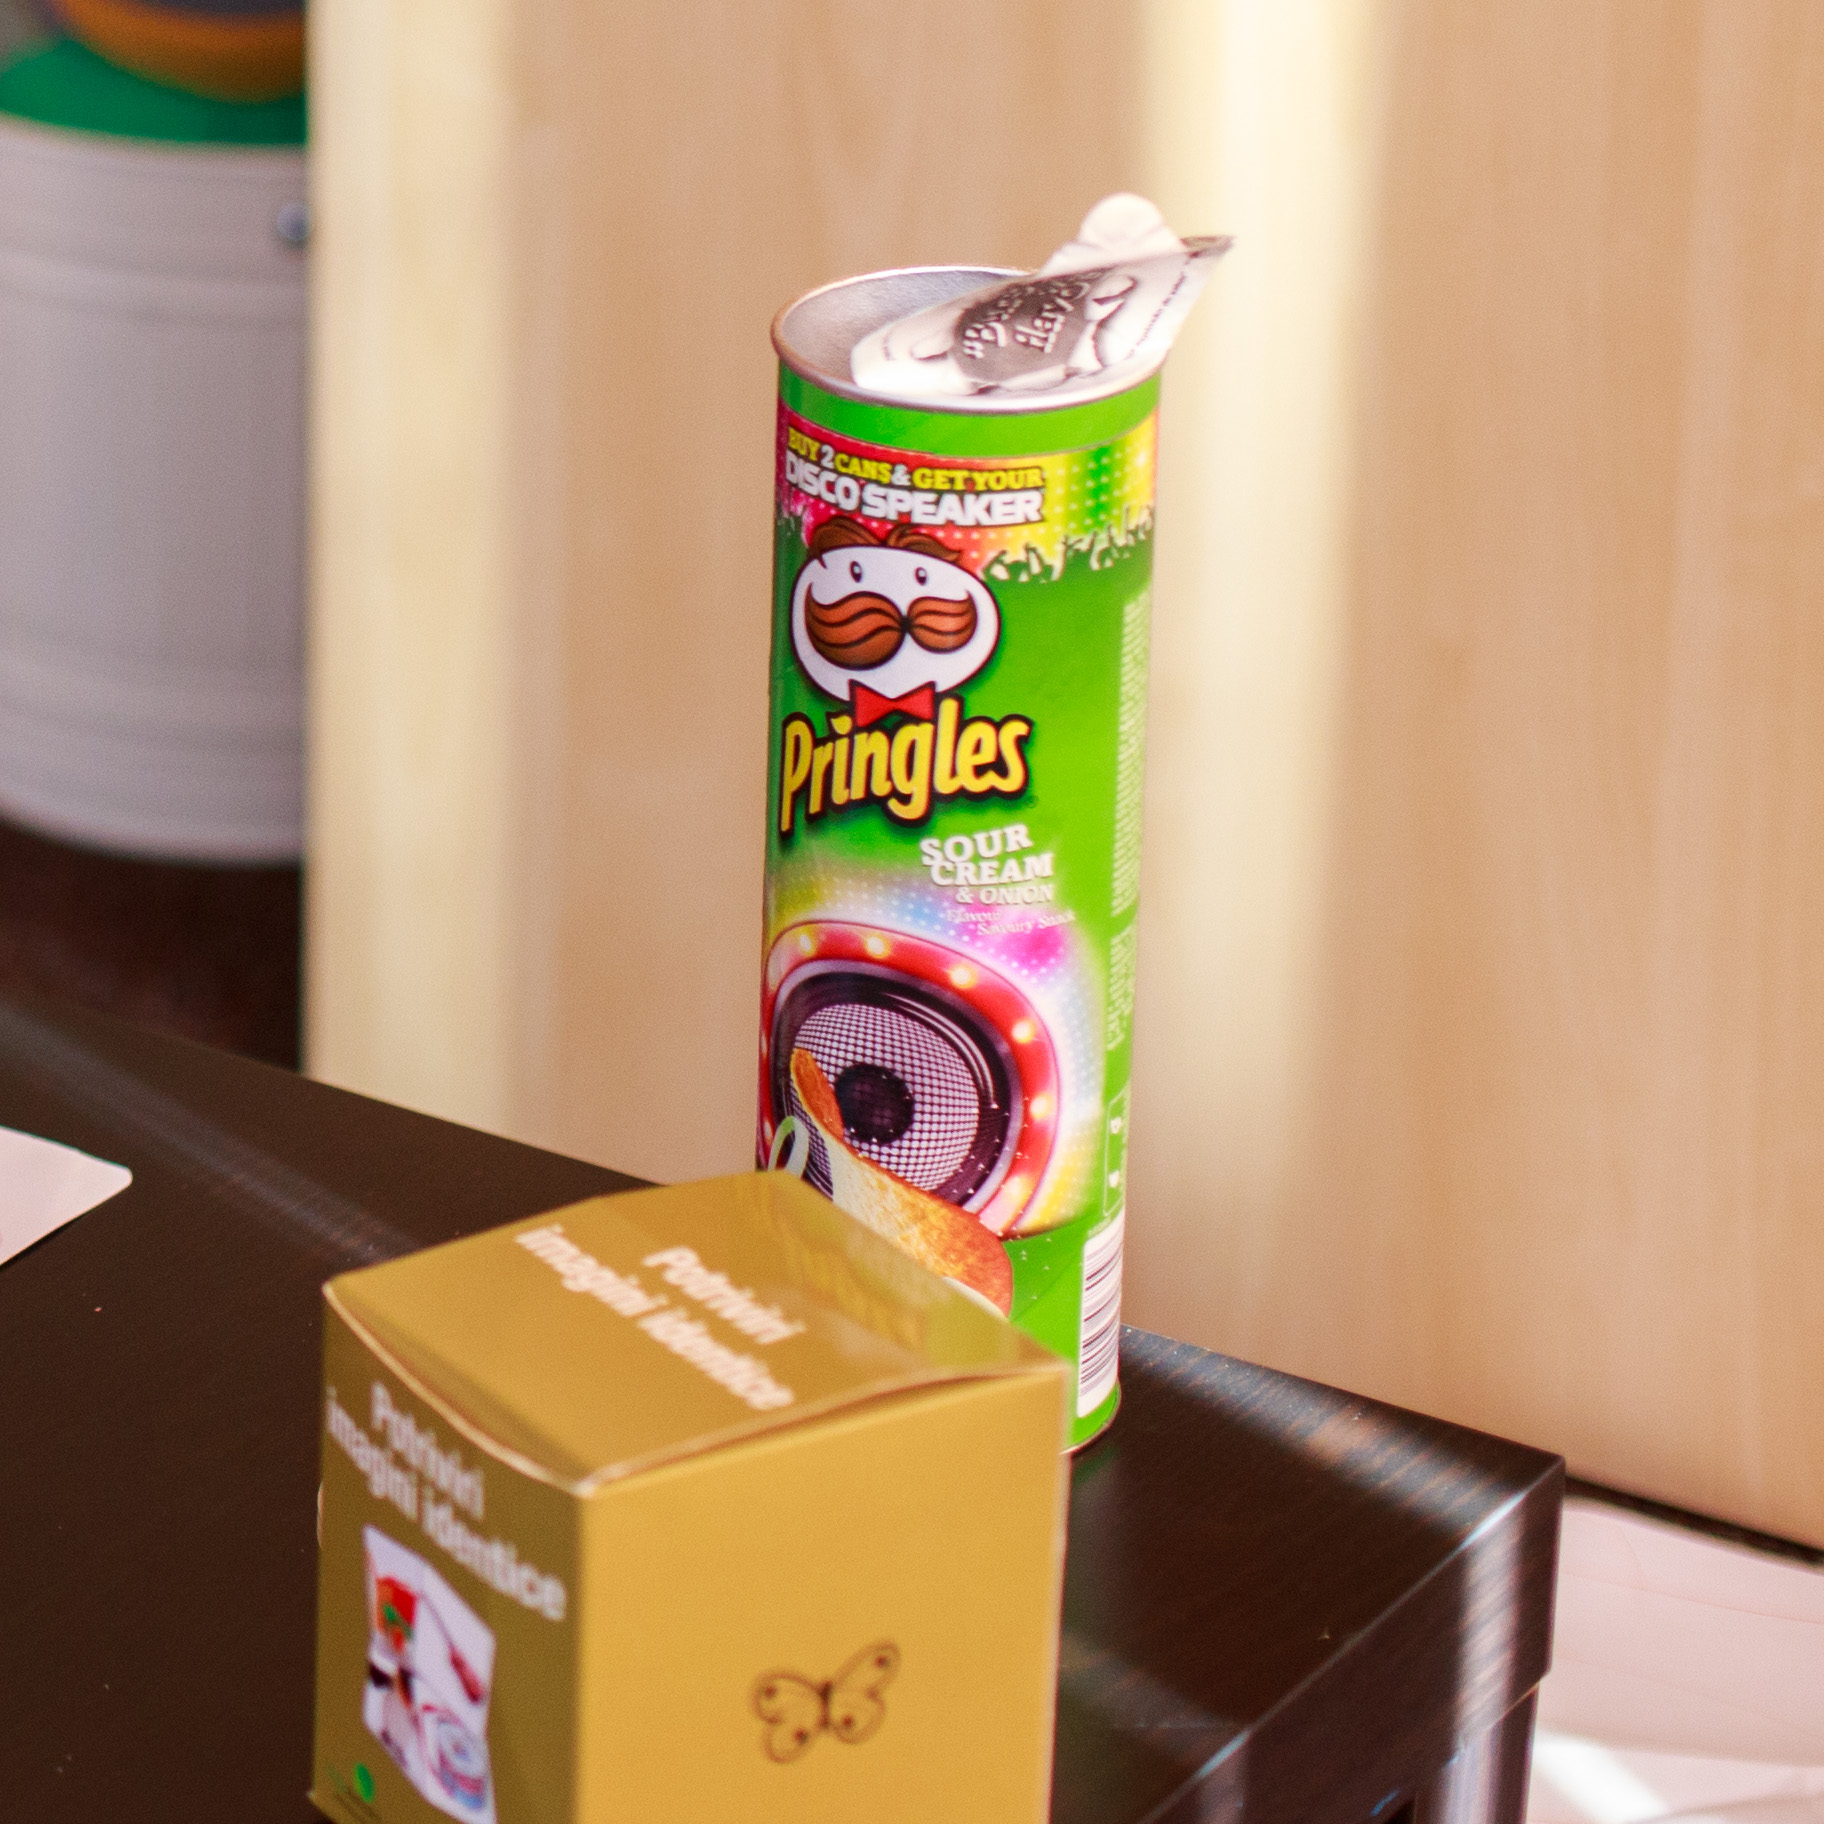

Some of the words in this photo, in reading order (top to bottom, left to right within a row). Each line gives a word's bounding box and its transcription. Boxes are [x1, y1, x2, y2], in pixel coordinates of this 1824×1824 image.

[786, 449, 861, 511] DISCO
[862, 483, 1044, 526] SPEAKER
[788, 428, 821, 461] BUY
[821, 445, 834, 469] 2
[835, 453, 893, 483] CANS
[891, 465, 911, 486] &
[912, 467, 971, 490] GET
[970, 466, 1044, 490] YOUR
[780, 696, 1034, 835] Pringles
[920, 823, 1034, 866] SOUR
[930, 852, 1054, 886] CREAM
[955, 886, 974, 904] &
[979, 884, 1054, 905] ONION
[422, 1485, 567, 1622] identice
